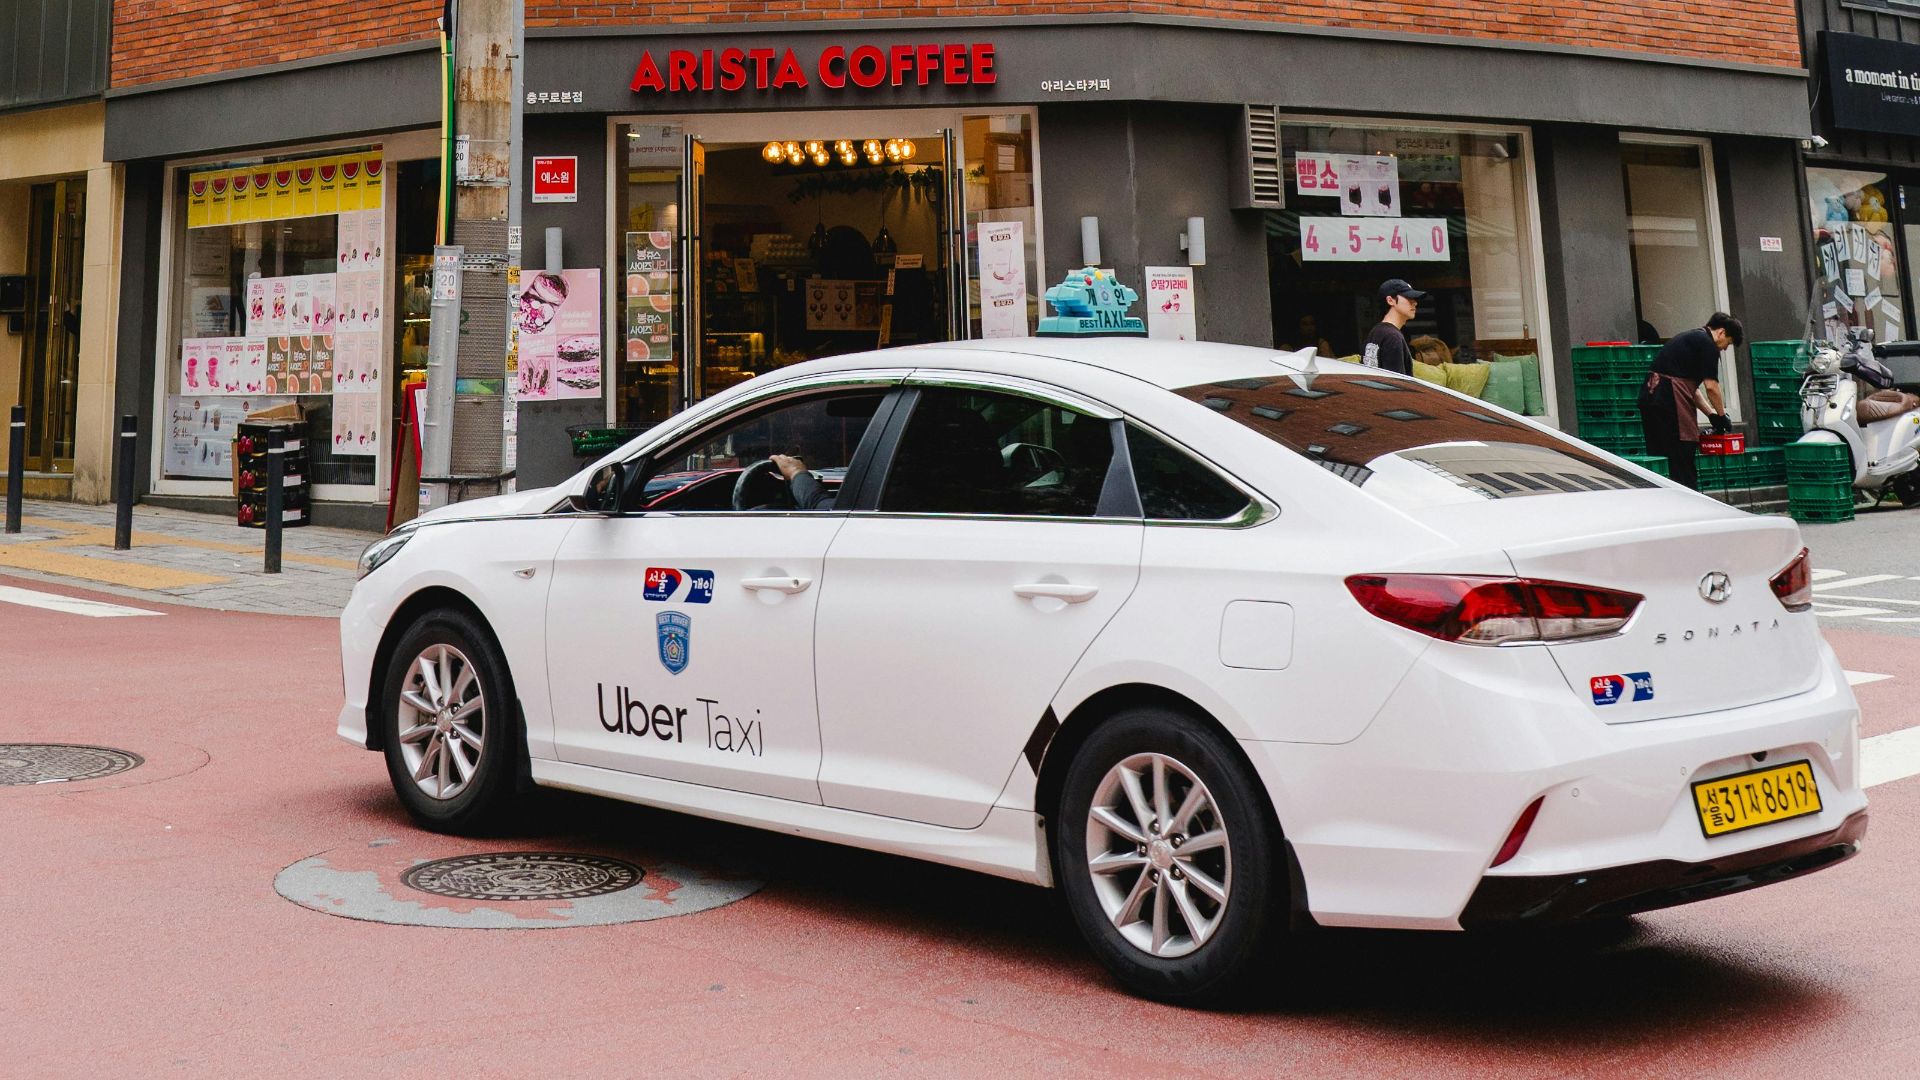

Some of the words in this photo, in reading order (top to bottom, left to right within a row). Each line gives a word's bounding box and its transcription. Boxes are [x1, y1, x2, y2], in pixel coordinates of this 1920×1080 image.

[630, 47, 808, 92] ARISTA
[818, 43, 998, 88] COFFEE
[1041, 78, 1111, 91] 아리스타커피
[1845, 68, 1853, 82] a
[1854, 69, 1898, 88] moment
[1897, 69, 1910, 90] in
[526, 90, 583, 105] 충무로본점
[540, 171, 570, 184] 에스원
[1298, 159, 1339, 189] 뱅쇼
[440, 274, 455, 287] 20
[1085, 288, 1098, 306] 개
[1114, 288, 1126, 306] 인
[1080, 320, 1098, 329] BEST
[1096, 310, 1124, 329] TAXI
[649, 570, 668, 593] 서울
[692, 577, 714, 597] 개인
[1655, 619, 1780, 645] SONATA
[1594, 677, 1614, 697] 서울
[1634, 677, 1654, 694] 개인
[597, 682, 688, 744] Uber
[696, 697, 763, 757] Taxi
[1706, 787, 1724, 827] 서울
